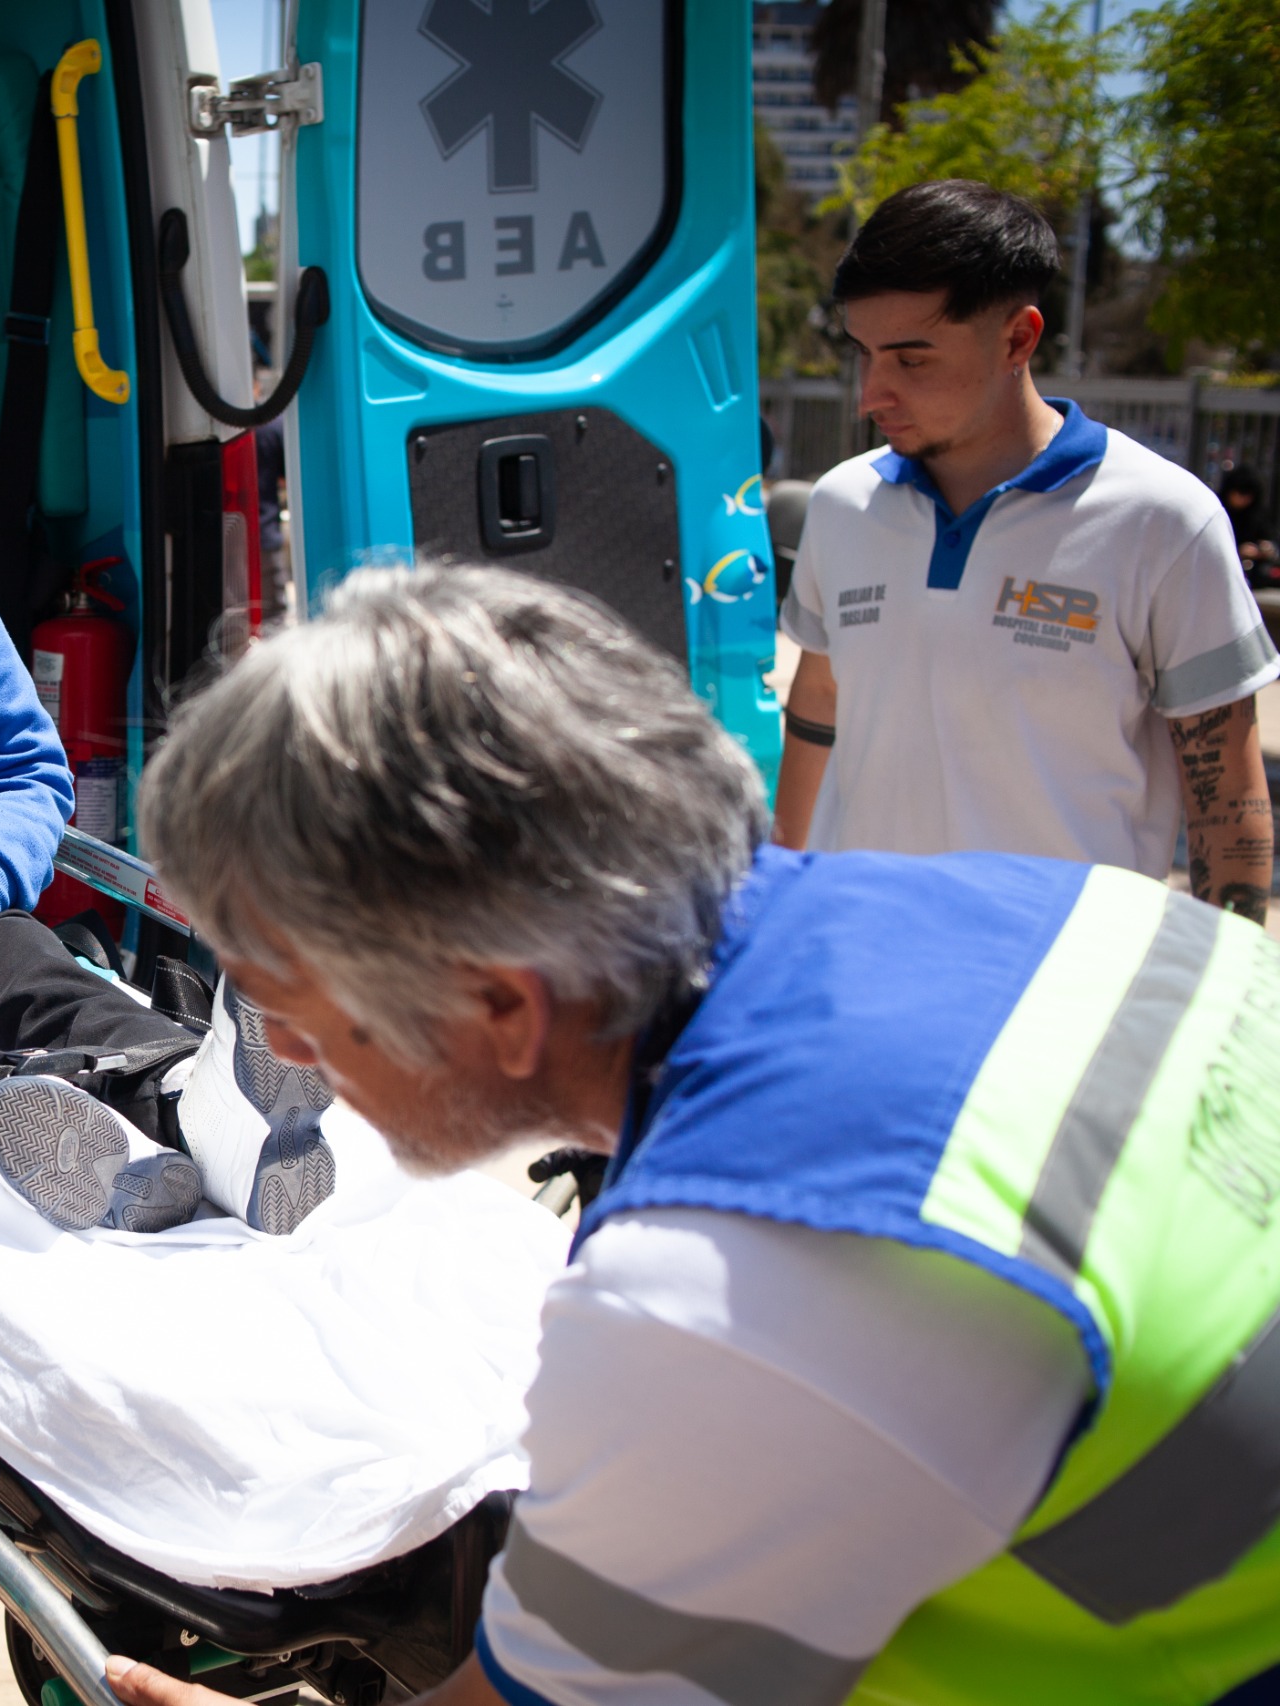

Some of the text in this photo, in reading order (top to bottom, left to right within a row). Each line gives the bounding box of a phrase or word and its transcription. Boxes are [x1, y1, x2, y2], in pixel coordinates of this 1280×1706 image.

[992, 614, 1096, 645] HOSPITAL SAN PABLO
